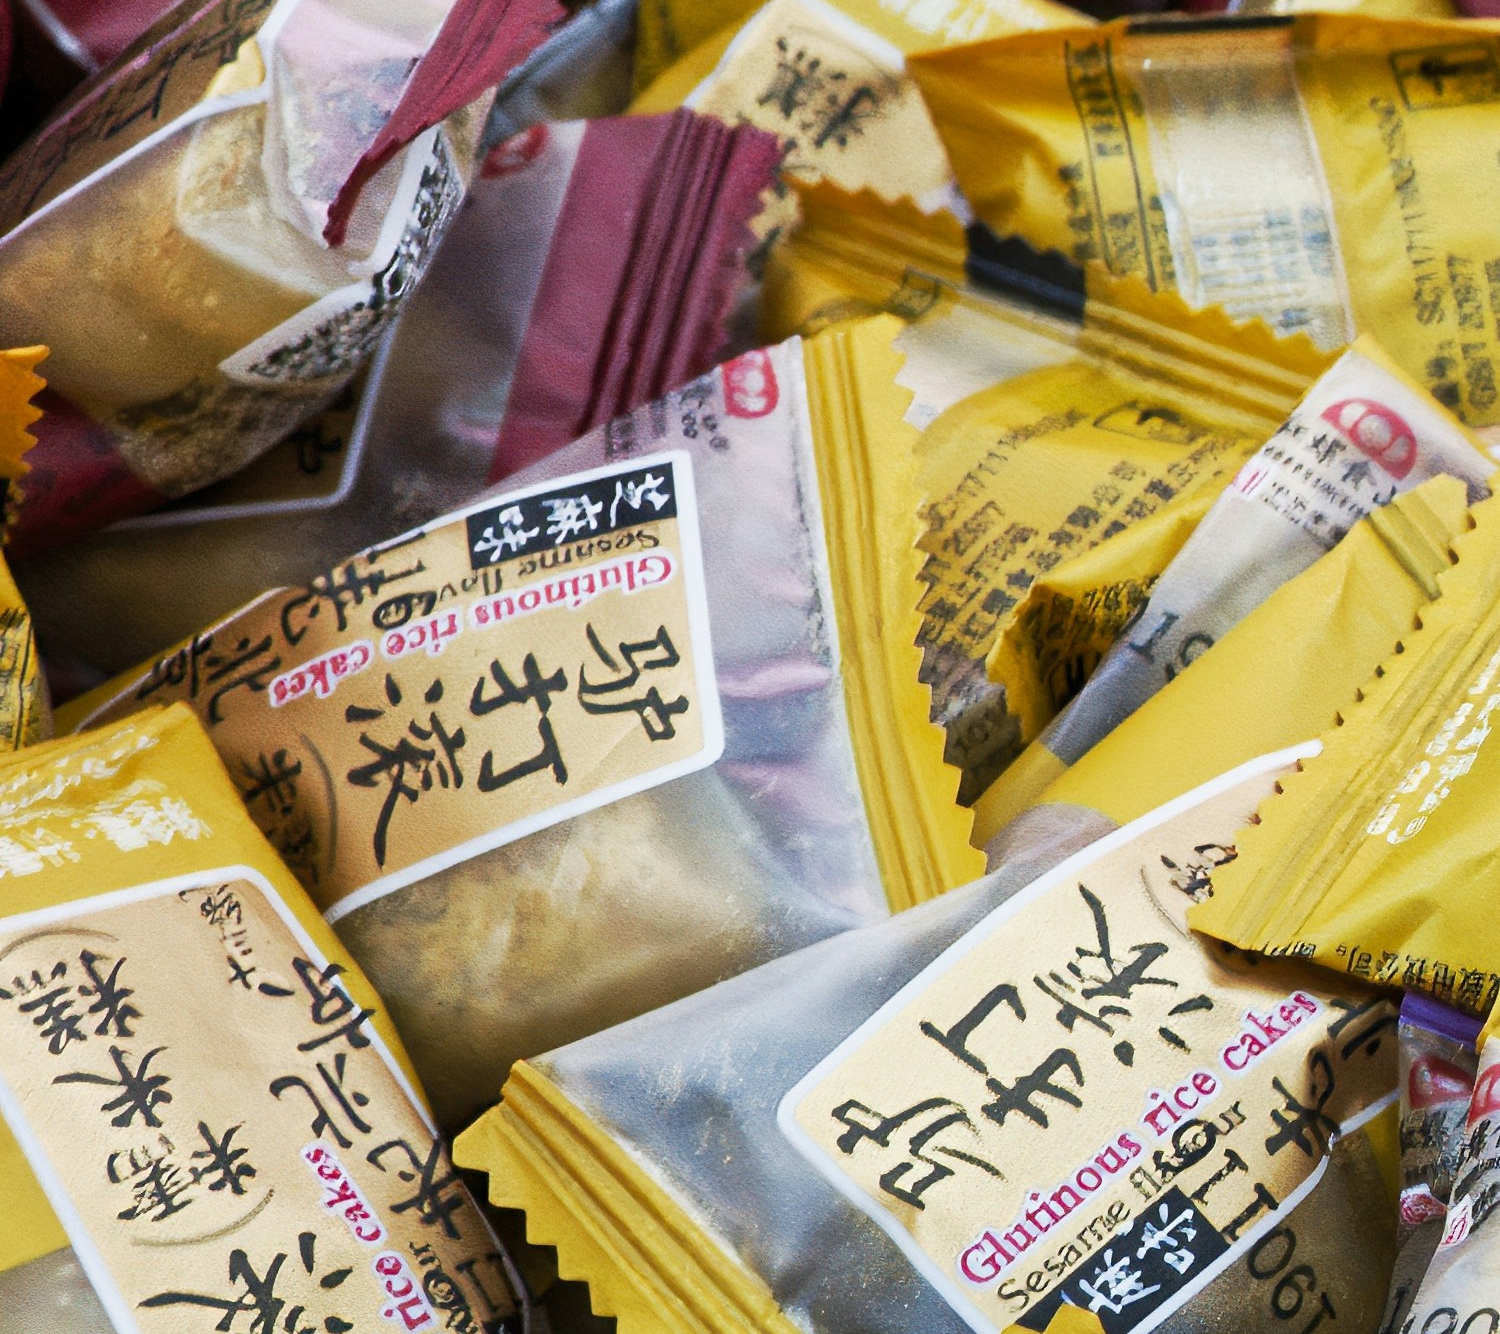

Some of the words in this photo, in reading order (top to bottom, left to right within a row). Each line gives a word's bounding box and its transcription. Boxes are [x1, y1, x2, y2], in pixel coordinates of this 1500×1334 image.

[473, 469, 672, 562] 芝麻味
[384, 610, 460, 656] rice
[473, 553, 674, 629] Glutinous
[271, 643, 371, 705] cakes
[343, 622, 691, 868] 驴打滚
[831, 881, 1213, 1211] 驴打滚
[256, 956, 465, 1239] 老北京
[959, 1133, 1144, 1283] Glutinous
[1143, 1072, 1217, 1135] rice
[1223, 990, 1318, 1072] cakes
[304, 1143, 384, 1245] cakes
[373, 1254, 434, 1332] rice
[999, 1199, 1131, 1315] Sesame
